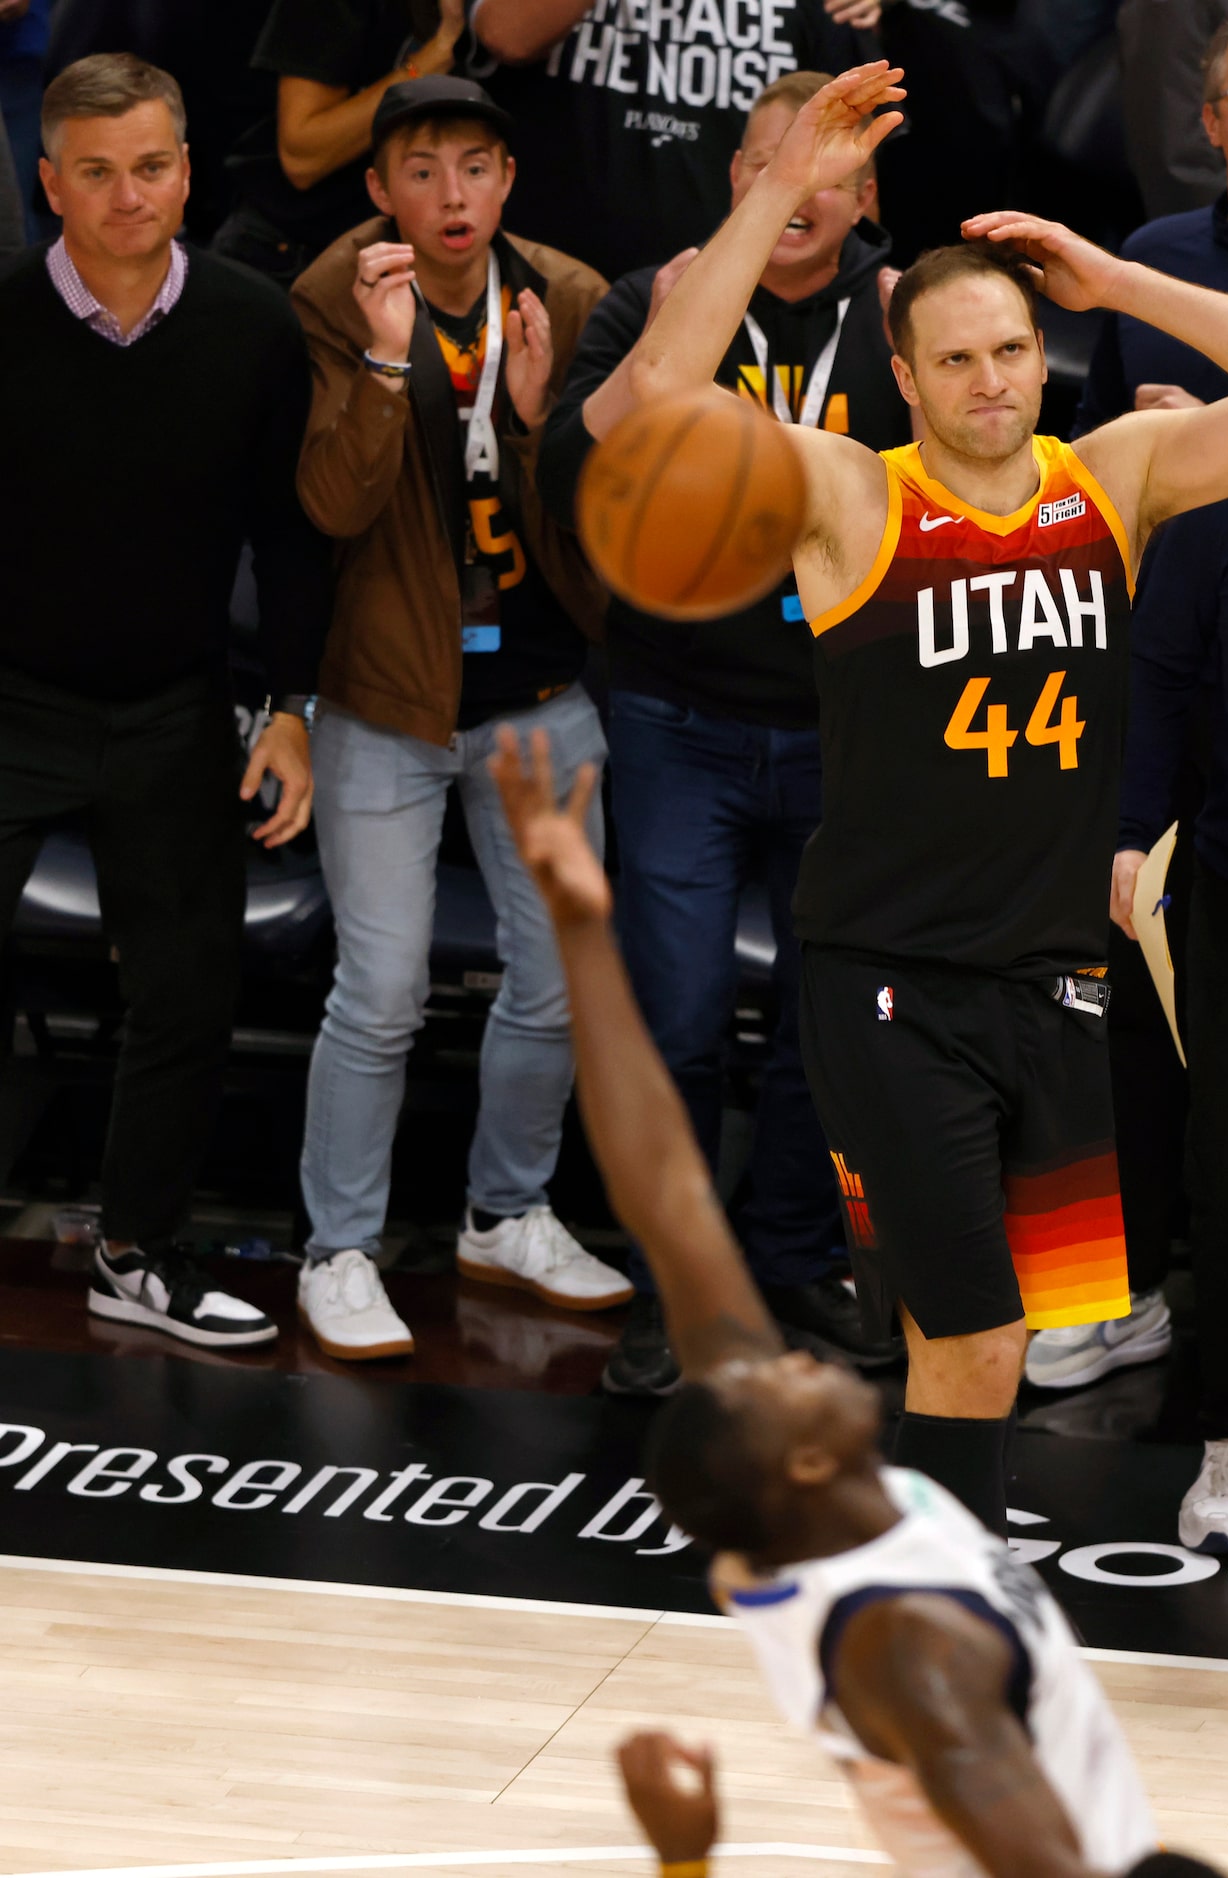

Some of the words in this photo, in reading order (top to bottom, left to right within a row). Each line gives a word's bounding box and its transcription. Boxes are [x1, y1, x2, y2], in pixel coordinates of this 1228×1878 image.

[583, 0, 797, 54] MBRACE
[1040, 505, 1050, 525] 5
[1055, 503, 1084, 521] FIGHT
[916, 568, 1108, 669] UTAH
[943, 670, 1087, 779] 44
